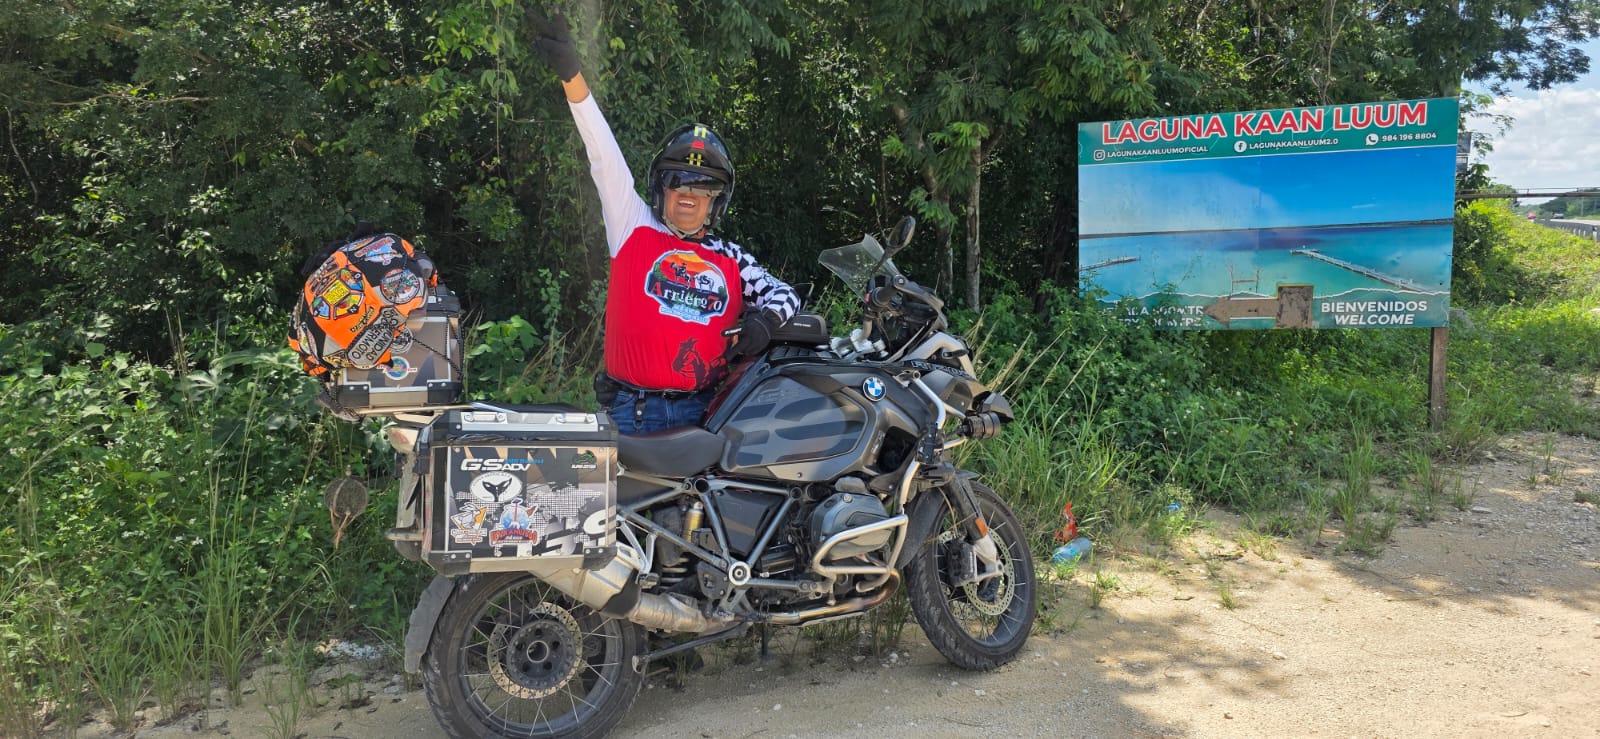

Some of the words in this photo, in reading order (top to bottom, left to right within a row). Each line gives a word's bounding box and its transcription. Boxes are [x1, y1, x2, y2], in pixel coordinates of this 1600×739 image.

[1102, 115, 1227, 145] LAGUNA
[1234, 108, 1324, 137] KAAN
[1333, 101, 1428, 131] LUUM
[1382, 134, 1397, 143] 984
[1399, 133, 1413, 141] 196
[1415, 132, 1437, 140] 8804
[1249, 138, 1338, 150] LAGUNAKAANLUUM2.0
[1107, 146, 1208, 158] LAGUNAKAANLUUMOFICIAL
[1321, 300, 1428, 313] BIENVENIDOS
[1334, 313, 1415, 325] WELCOME
[366, 318, 399, 361] CUNIDAD
